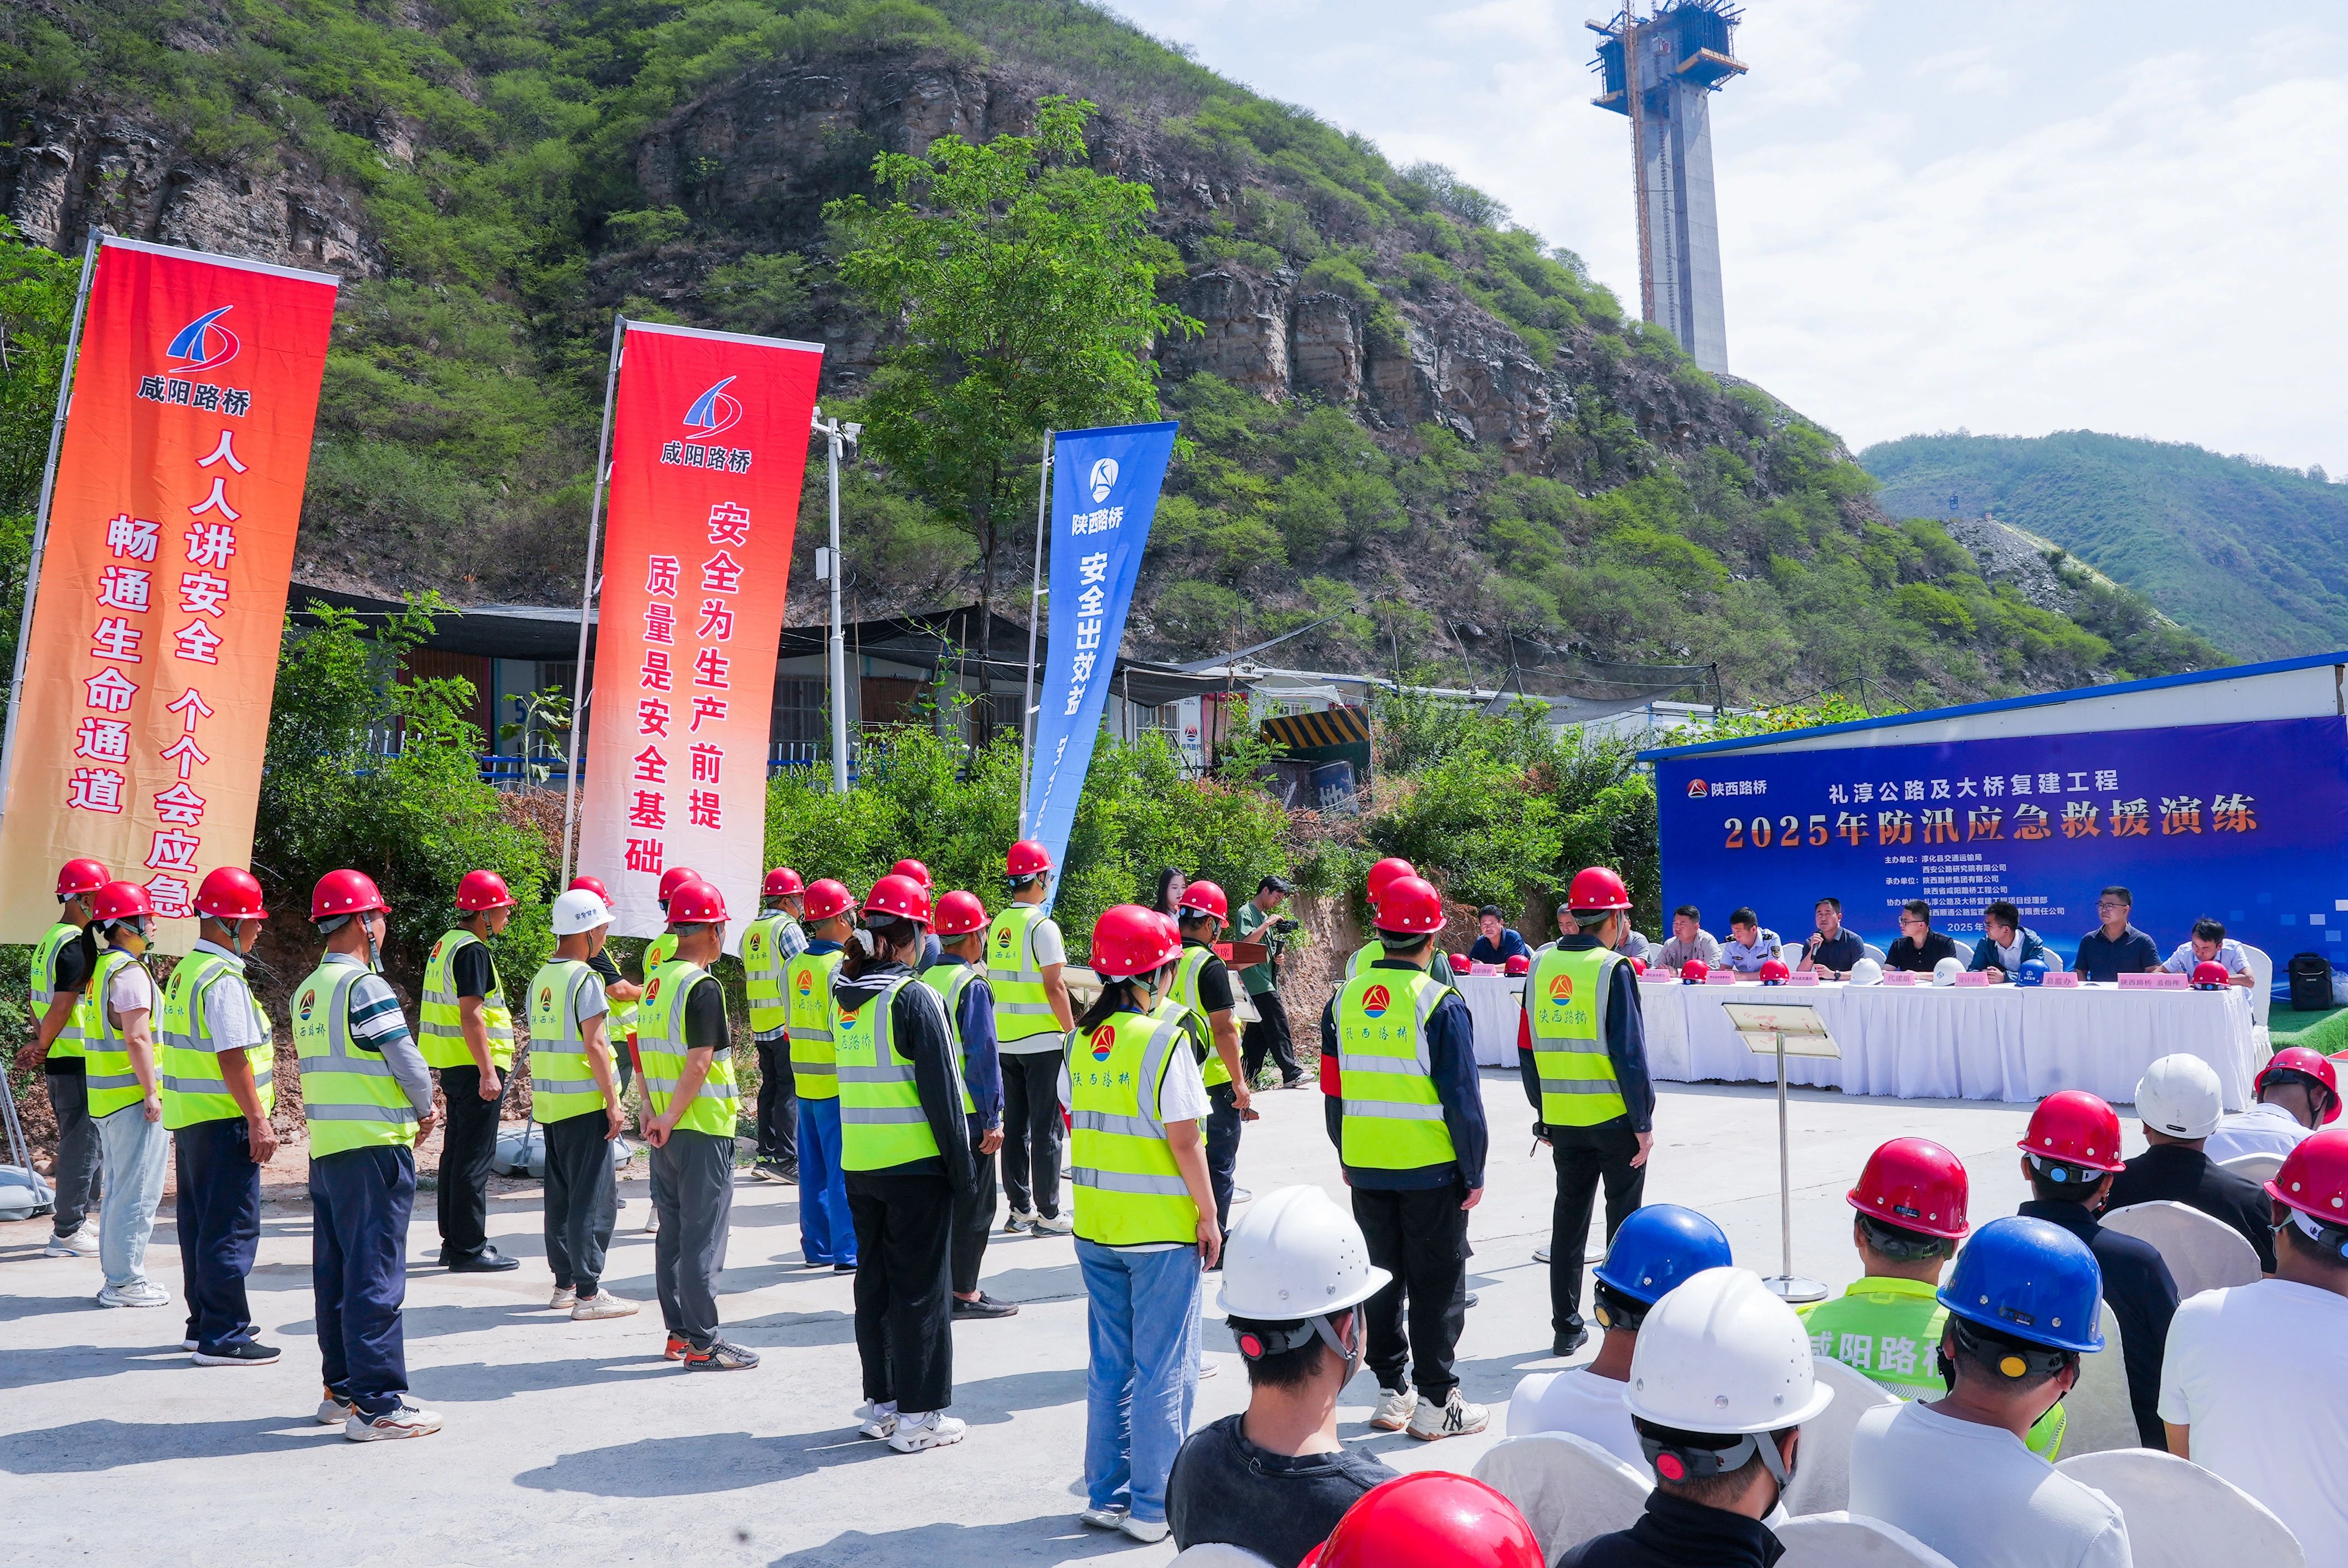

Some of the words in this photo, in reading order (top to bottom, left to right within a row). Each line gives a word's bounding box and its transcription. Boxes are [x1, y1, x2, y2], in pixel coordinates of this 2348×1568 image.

[137, 374, 251, 418] 咸阳路桥
[660, 439, 753, 475] 咸阳路桥
[174, 429, 249, 664] 人人讲安全
[67, 513, 162, 814] 畅通生命通道
[688, 501, 750, 831] 安全为生产前提
[624, 554, 681, 876] 质量是安全基础
[143, 687, 215, 919] 个个会应急
[1711, 780, 1767, 797] 陕西路桥
[1829, 769, 2119, 805] 礼淳公路及大桥复建工程
[1723, 793, 2258, 849] 2025年防汛应急救援演练
[1922, 864, 2007, 874] 西安公路研究院有限公司
[1923, 886, 2008, 895] 陕西省咸阳路桥工程公司
[2046, 977, 2072, 986] 总监办
[1345, 1025, 1408, 1043] 陕西路桥
[1539, 1009, 1588, 1024] 陕西路桥
[834, 1033, 872, 1051] 西路桥
[1073, 1070, 1130, 1091] 陕西路桥
